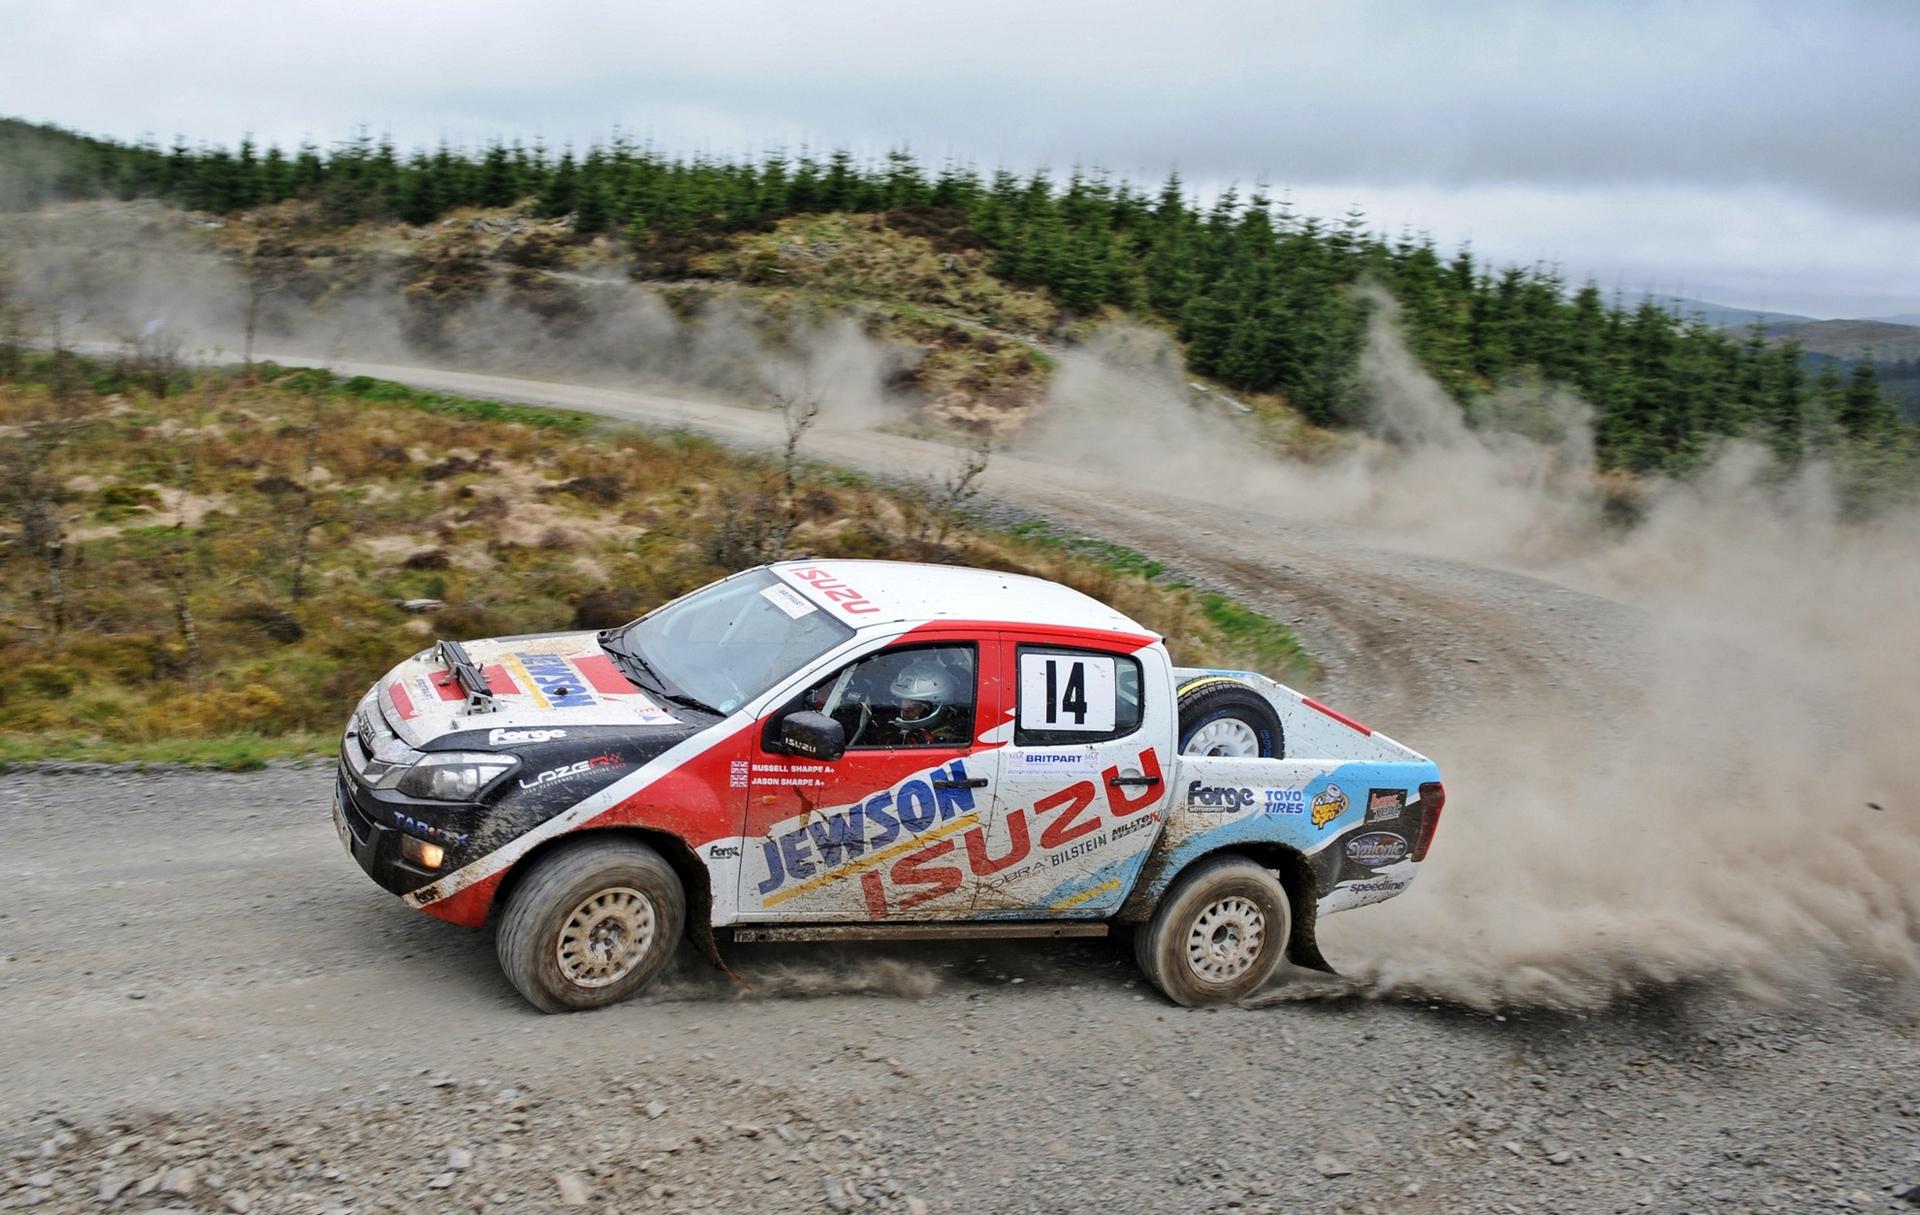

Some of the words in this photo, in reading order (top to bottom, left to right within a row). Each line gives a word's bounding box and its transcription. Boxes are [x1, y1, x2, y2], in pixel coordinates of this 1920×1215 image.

[788, 567, 880, 614] ISUZU
[514, 652, 597, 708] JEWSON
[1046, 660, 1087, 724] 14
[489, 729, 567, 746] Forge
[785, 737, 816, 753] ISUZU
[1026, 755, 1082, 763] BRITPART
[752, 764, 788, 772] RUSSELL
[791, 765, 824, 773] SHARPE
[781, 778, 813, 786] SHARPE
[1188, 780, 1255, 813] Forge
[1265, 791, 1302, 801] TOYO
[1264, 803, 1304, 814] TIRES
[757, 758, 976, 895] JEWSON
[861, 747, 1166, 920] ISUZU
[1051, 833, 1107, 868] BILSTEIN
[1350, 881, 1405, 894] speedline
